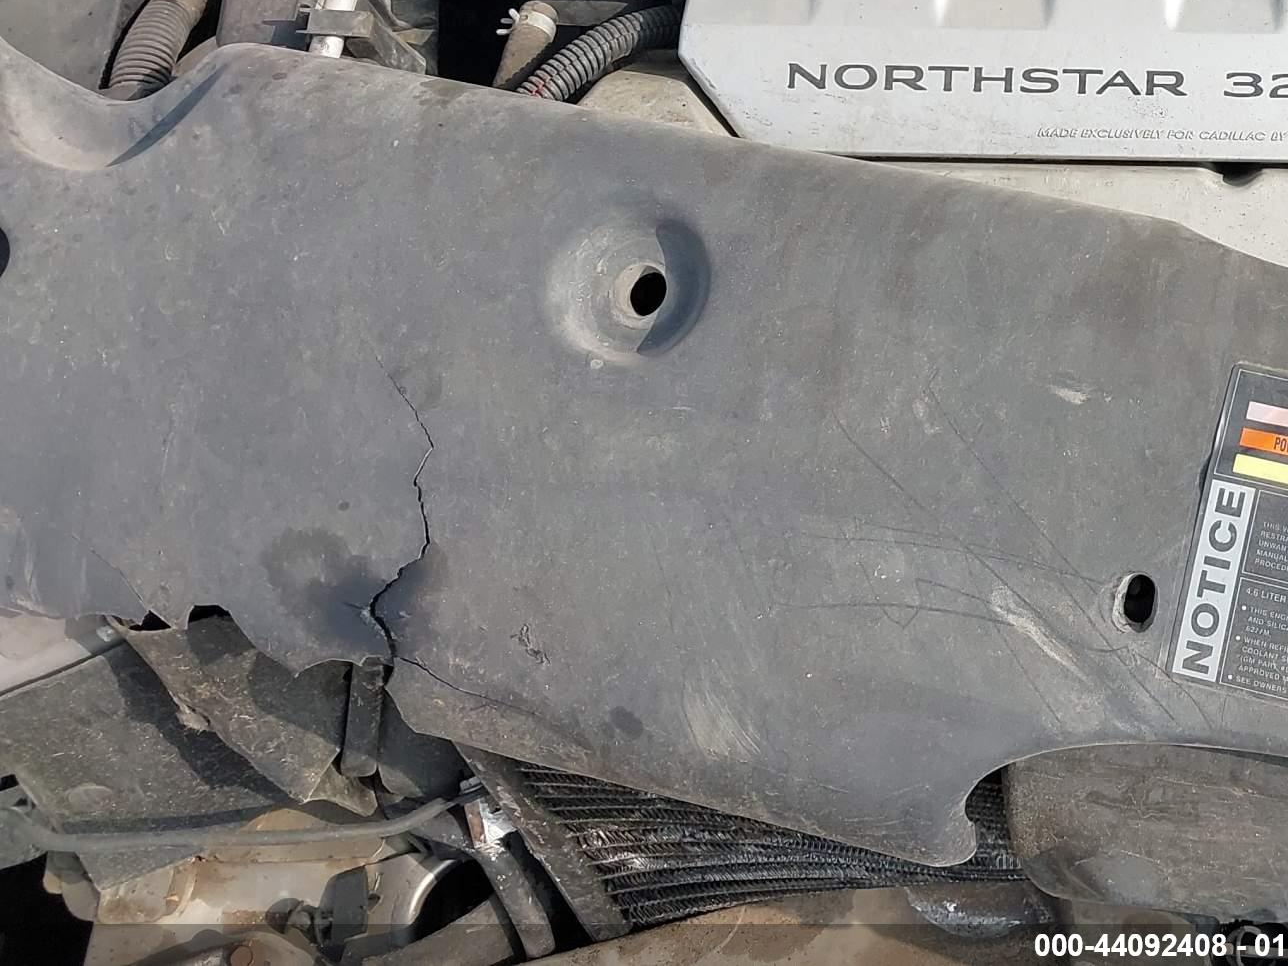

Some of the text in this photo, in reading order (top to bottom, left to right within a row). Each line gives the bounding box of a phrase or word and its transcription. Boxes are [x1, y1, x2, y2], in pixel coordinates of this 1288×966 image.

[787, 62, 1188, 96] NORTHSTAR
[1036, 128, 1077, 139] MADE
[1080, 128, 1164, 140] EXCLUSIVELY
[1167, 129, 1194, 140] FOR
[1198, 130, 1266, 142] CADILLAC
[1270, 132, 1287, 142] BY
[1256, 549, 1288, 562] MANUAL
[1182, 487, 1246, 674] NOTICE
[1245, 587, 1259, 596] 4.6
[1260, 590, 1286, 603] LITER
[1249, 606, 1267, 616] THIS
[1242, 636, 1266, 647] WHEN
[1241, 645, 1278, 660] COOLANT
[1238, 663, 1280, 680] APPROVED
